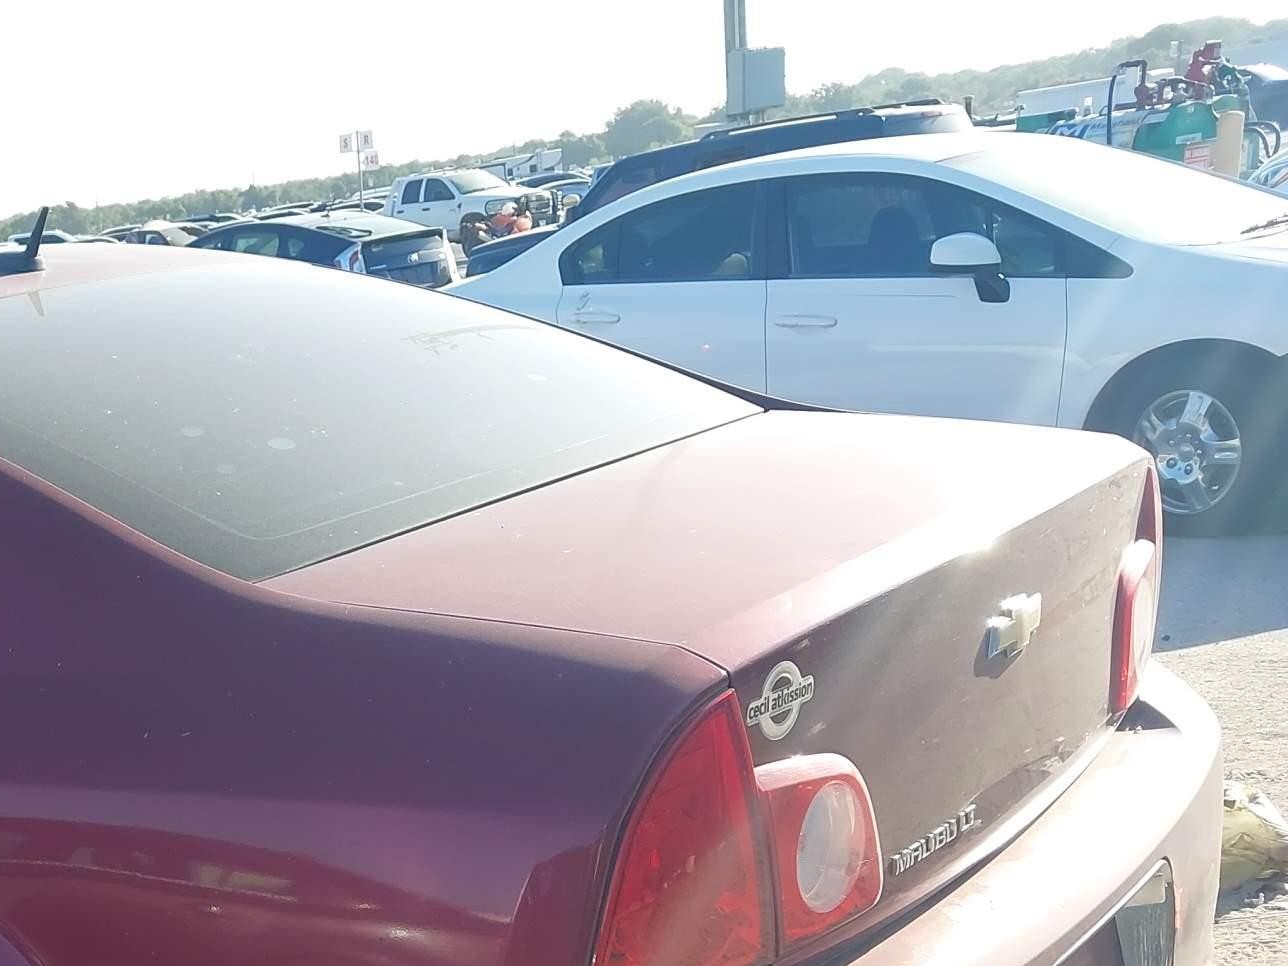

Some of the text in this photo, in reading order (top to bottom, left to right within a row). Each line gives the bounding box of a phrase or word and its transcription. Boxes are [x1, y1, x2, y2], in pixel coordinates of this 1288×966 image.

[748, 682, 813, 720] cecil atkission
[890, 818, 958, 876] MALIBU
